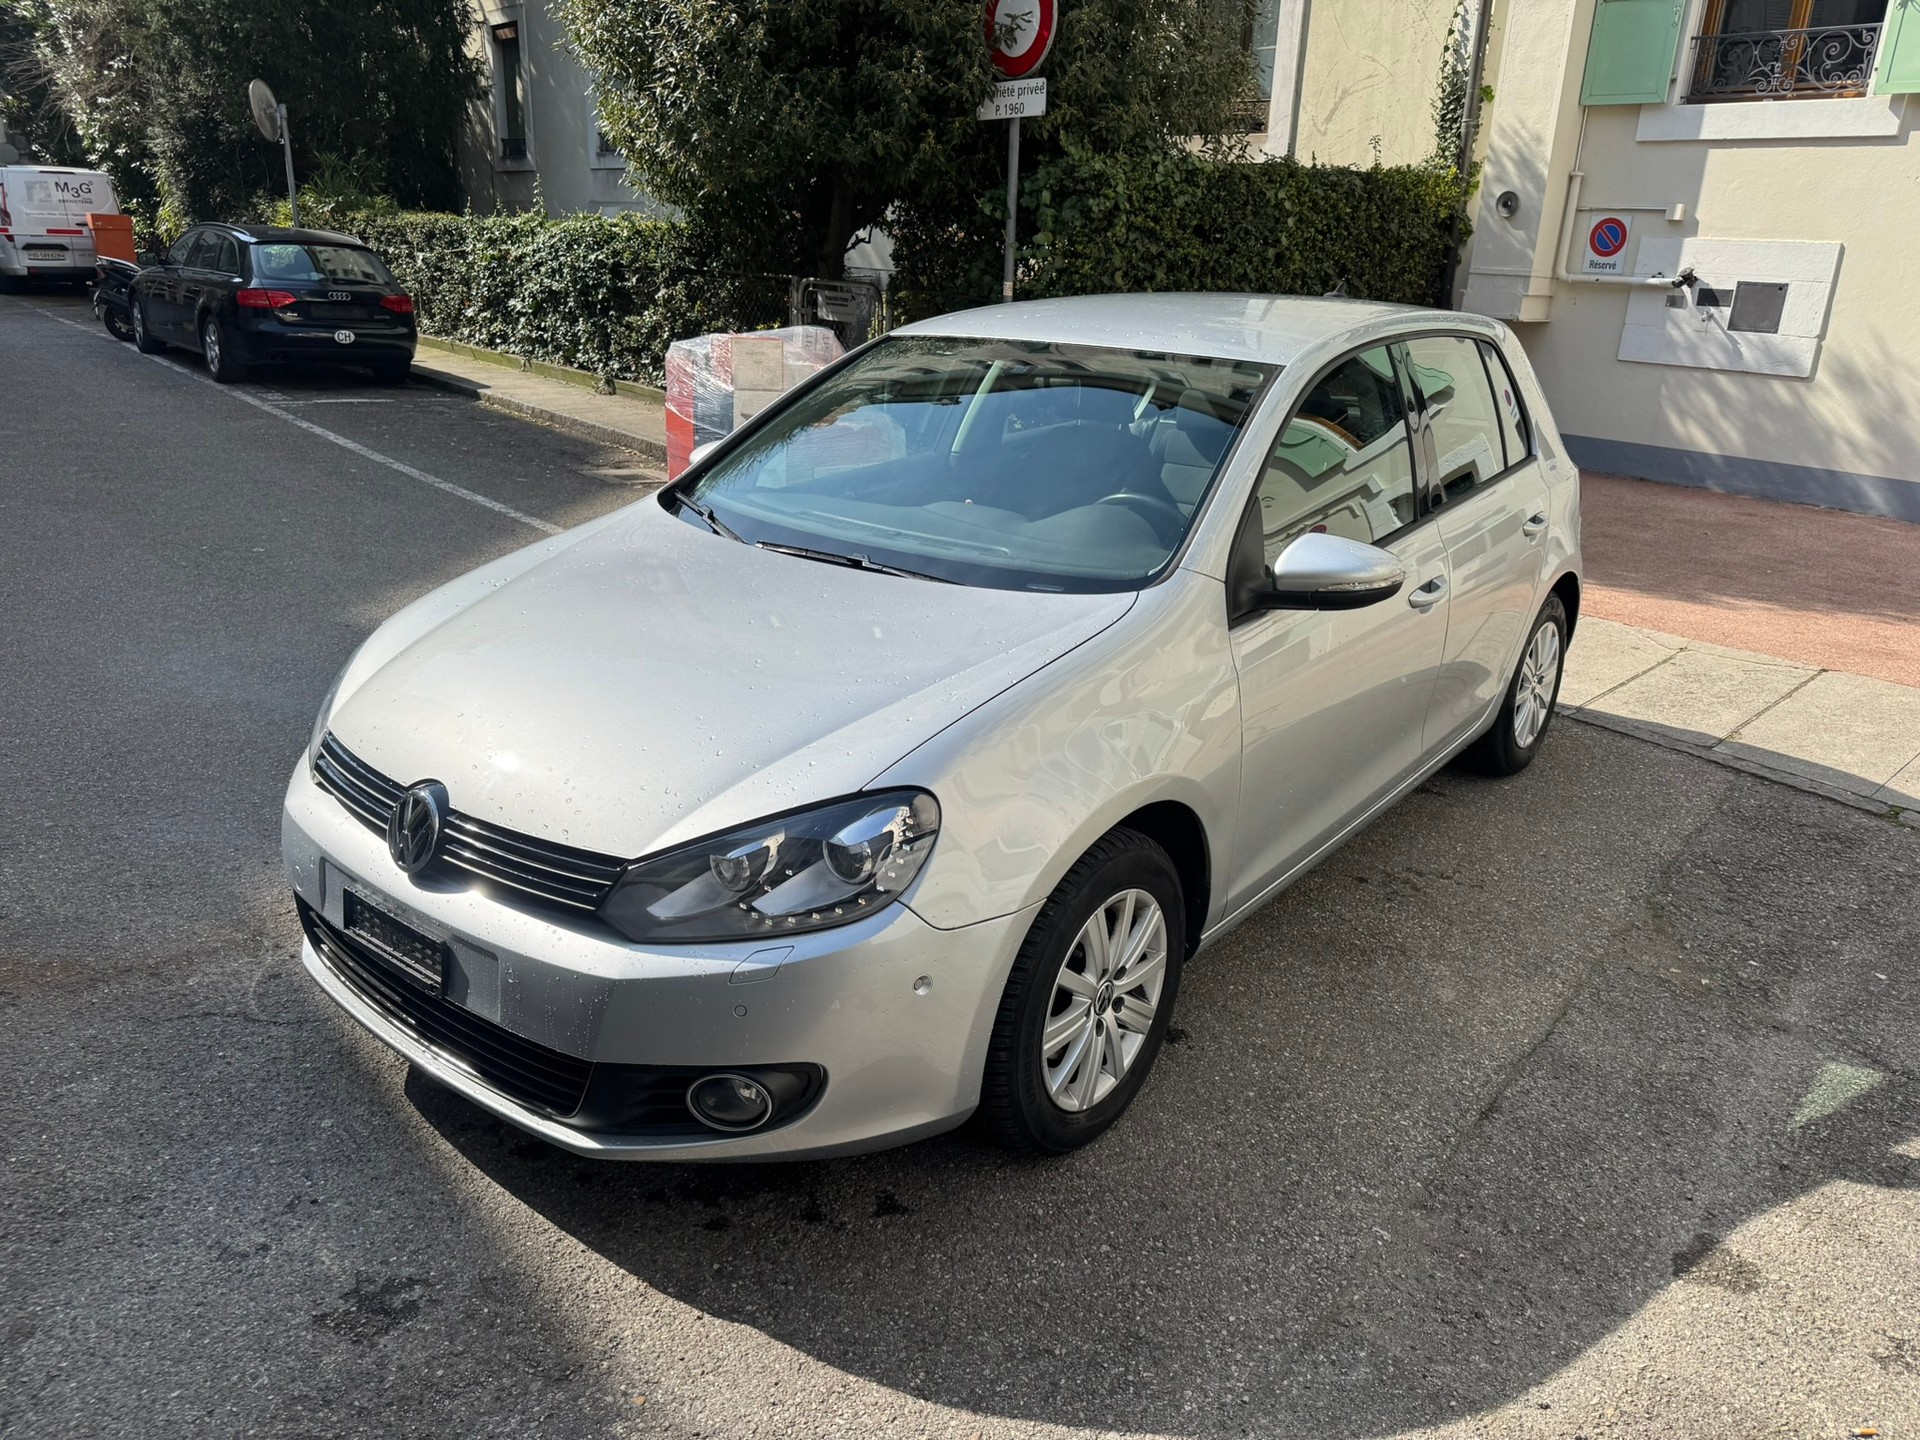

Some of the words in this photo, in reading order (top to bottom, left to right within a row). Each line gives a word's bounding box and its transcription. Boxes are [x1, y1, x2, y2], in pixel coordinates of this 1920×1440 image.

[1018, 82, 1045, 99] privée
[1004, 102, 1025, 116] 1960
[1589, 260, 1616, 270] Réservé
[337, 332, 351, 342] CH
